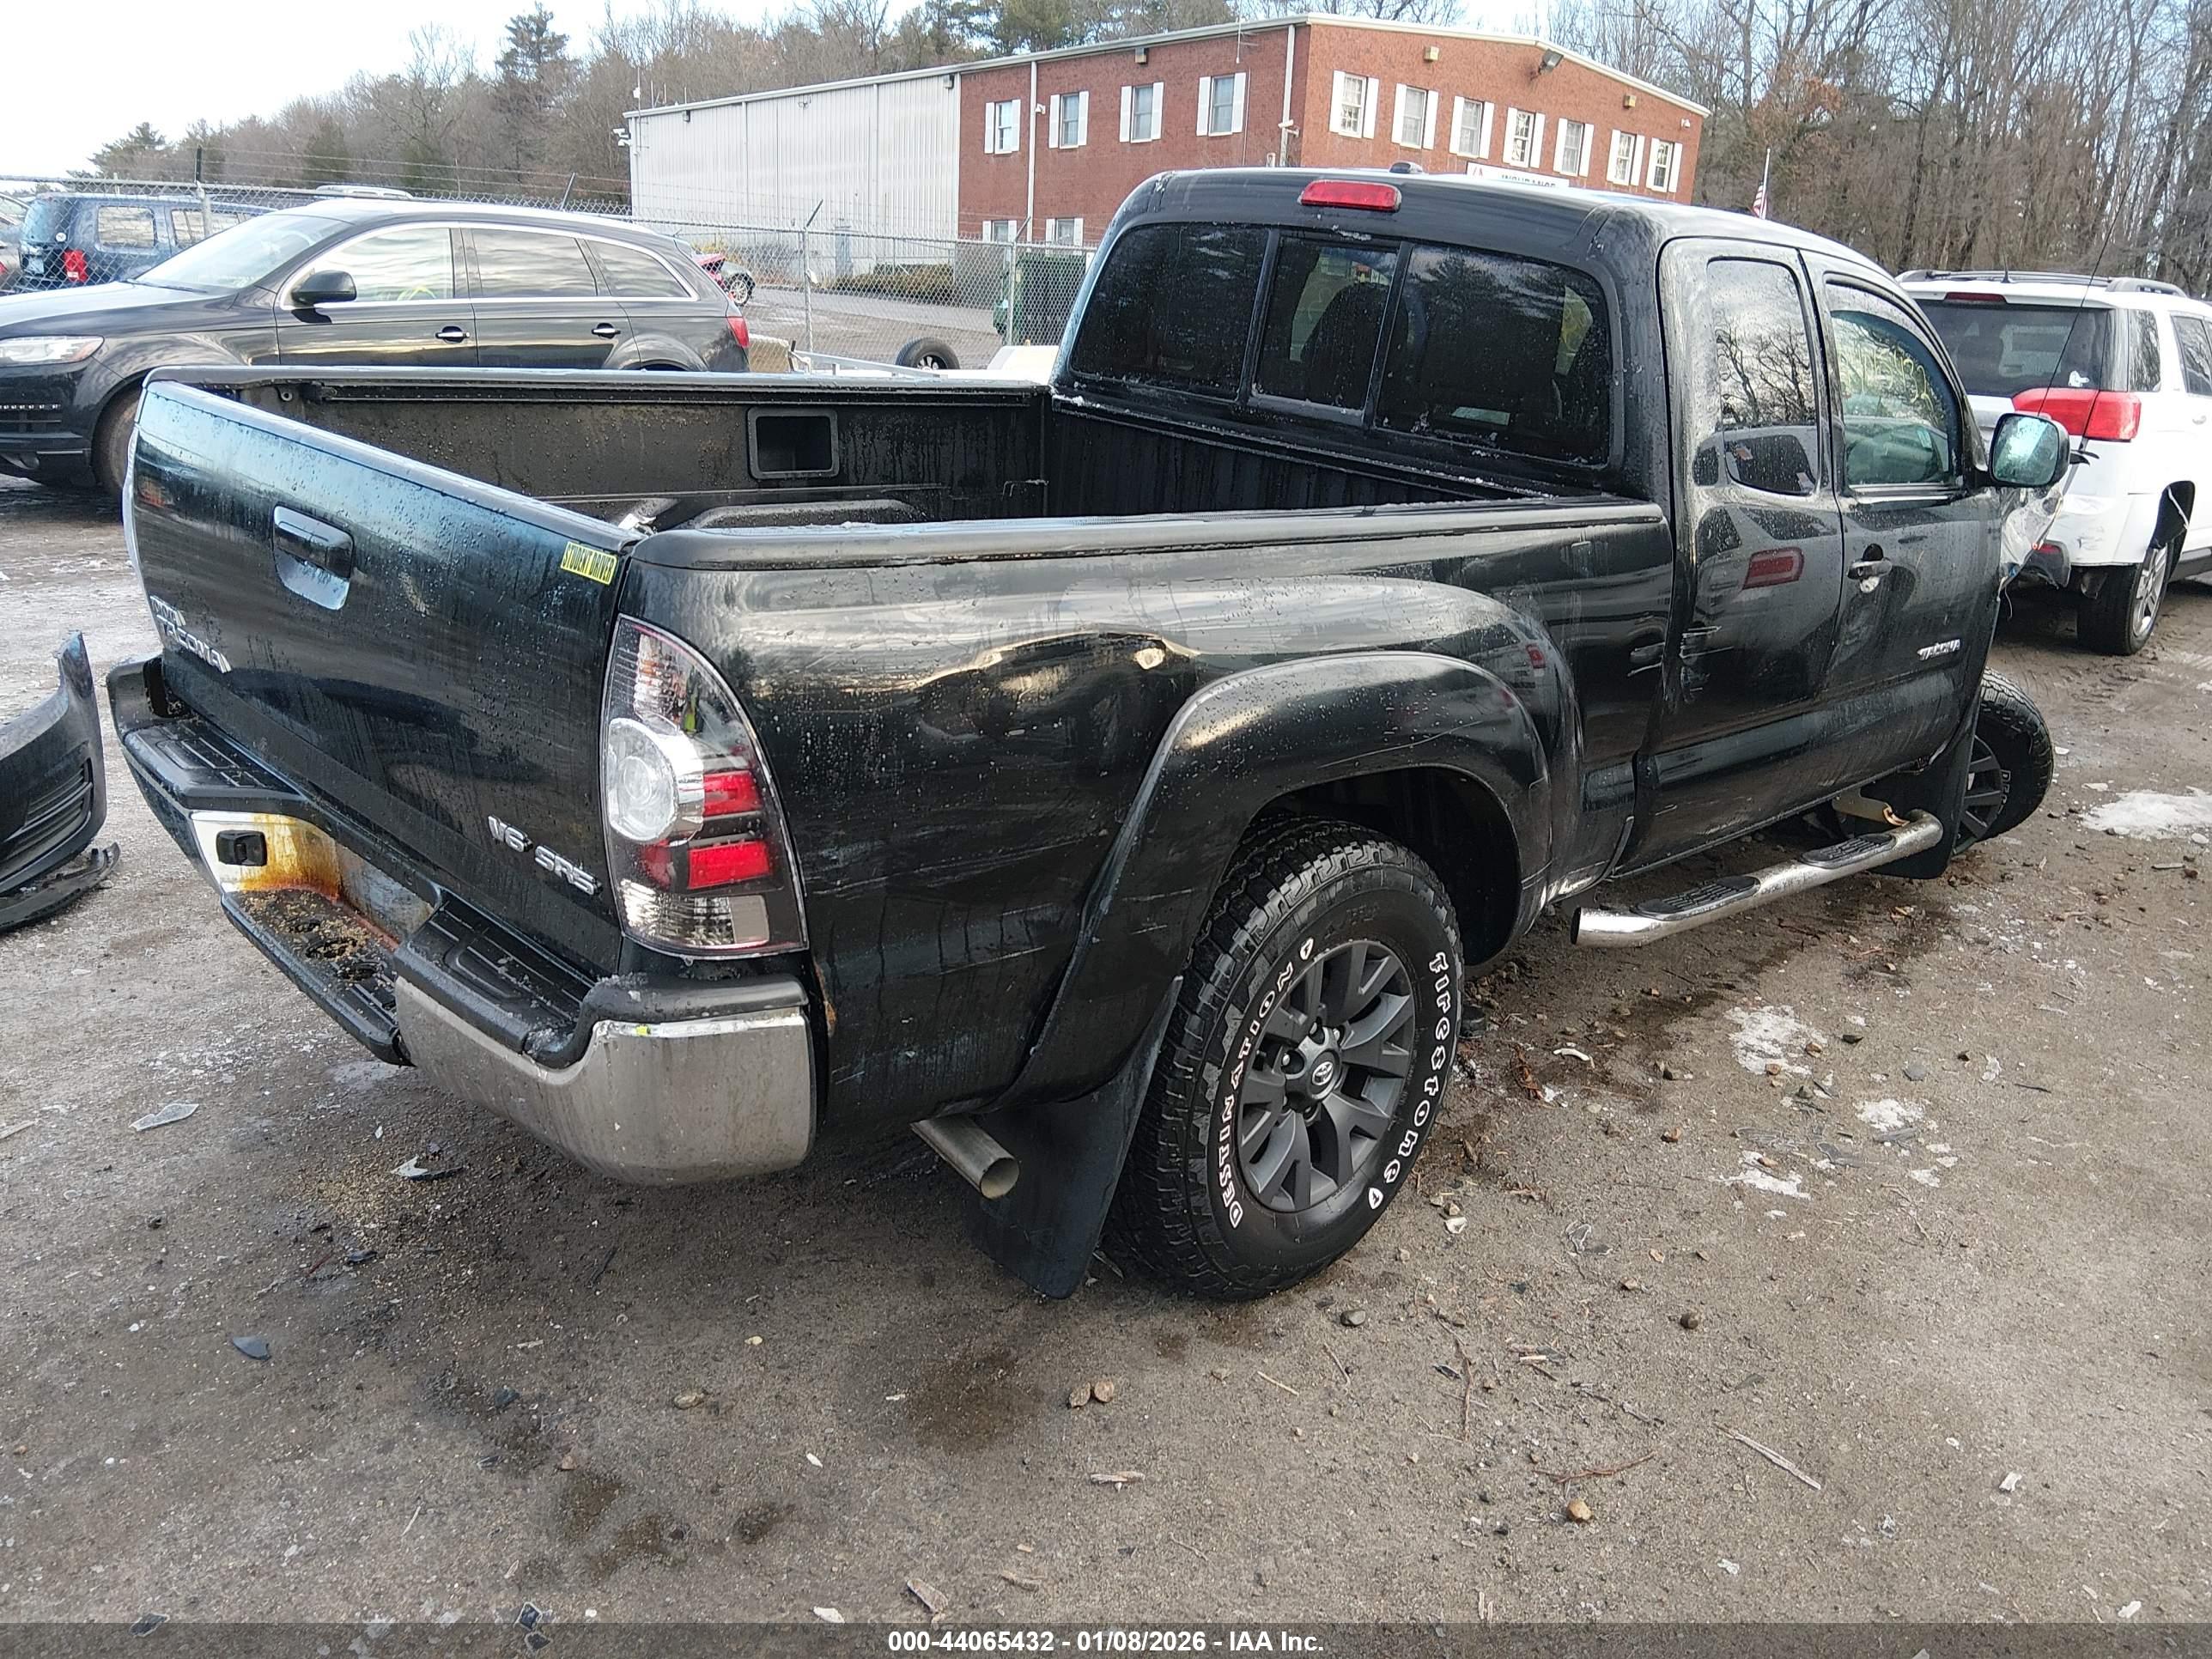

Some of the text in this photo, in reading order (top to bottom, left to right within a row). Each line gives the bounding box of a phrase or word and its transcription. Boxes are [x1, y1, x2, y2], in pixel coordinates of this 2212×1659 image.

[562, 542, 615, 583] STUDENT DRIVER
[156, 614, 232, 673] TACOMA
[488, 816, 598, 896] V6 SR5
[1216, 961, 1294, 1230] DESTINATION
